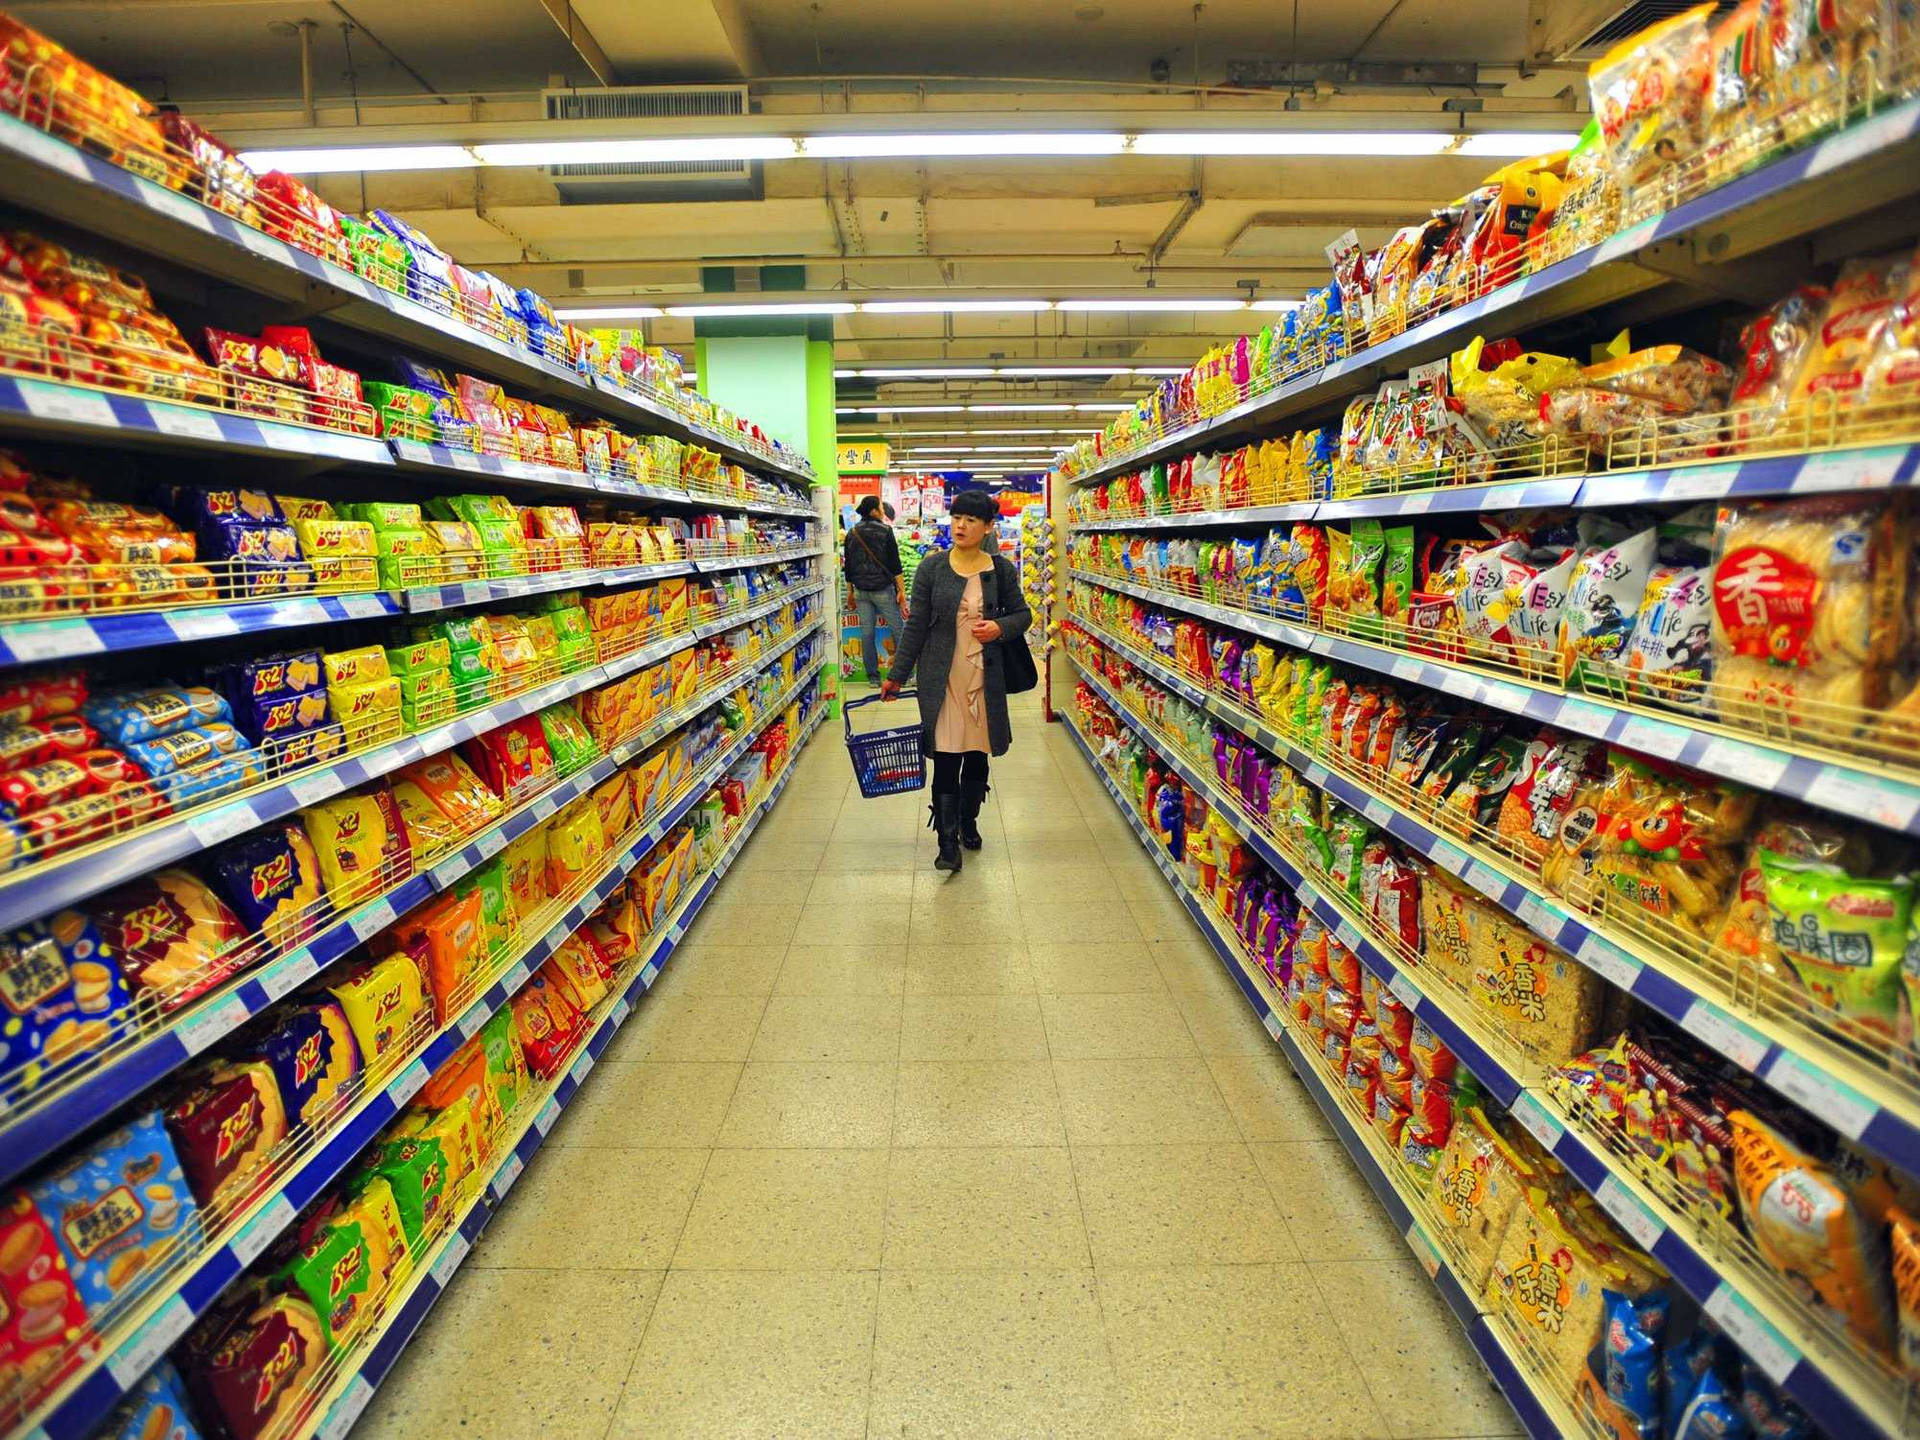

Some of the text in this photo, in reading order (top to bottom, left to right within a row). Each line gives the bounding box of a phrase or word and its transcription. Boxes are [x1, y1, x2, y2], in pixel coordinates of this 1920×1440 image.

[1473, 563, 1503, 589] Easy
[1528, 582, 1565, 612] Easy
[1716, 552, 1785, 626] 香
[1464, 588, 1489, 612] Life
[1650, 603, 1682, 636] Life
[1519, 609, 1550, 635] Life
[253, 666, 285, 695] 3+2
[264, 701, 296, 732] 3+2
[252, 854, 292, 901] 3+2
[122, 903, 173, 951] 3+2
[375, 982, 402, 1024] 3+2
[295, 1035, 321, 1086] 3+2
[218, 1101, 254, 1163] 3+2
[330, 1246, 362, 1298] 3+2
[256, 1338, 296, 1410] 3+2
